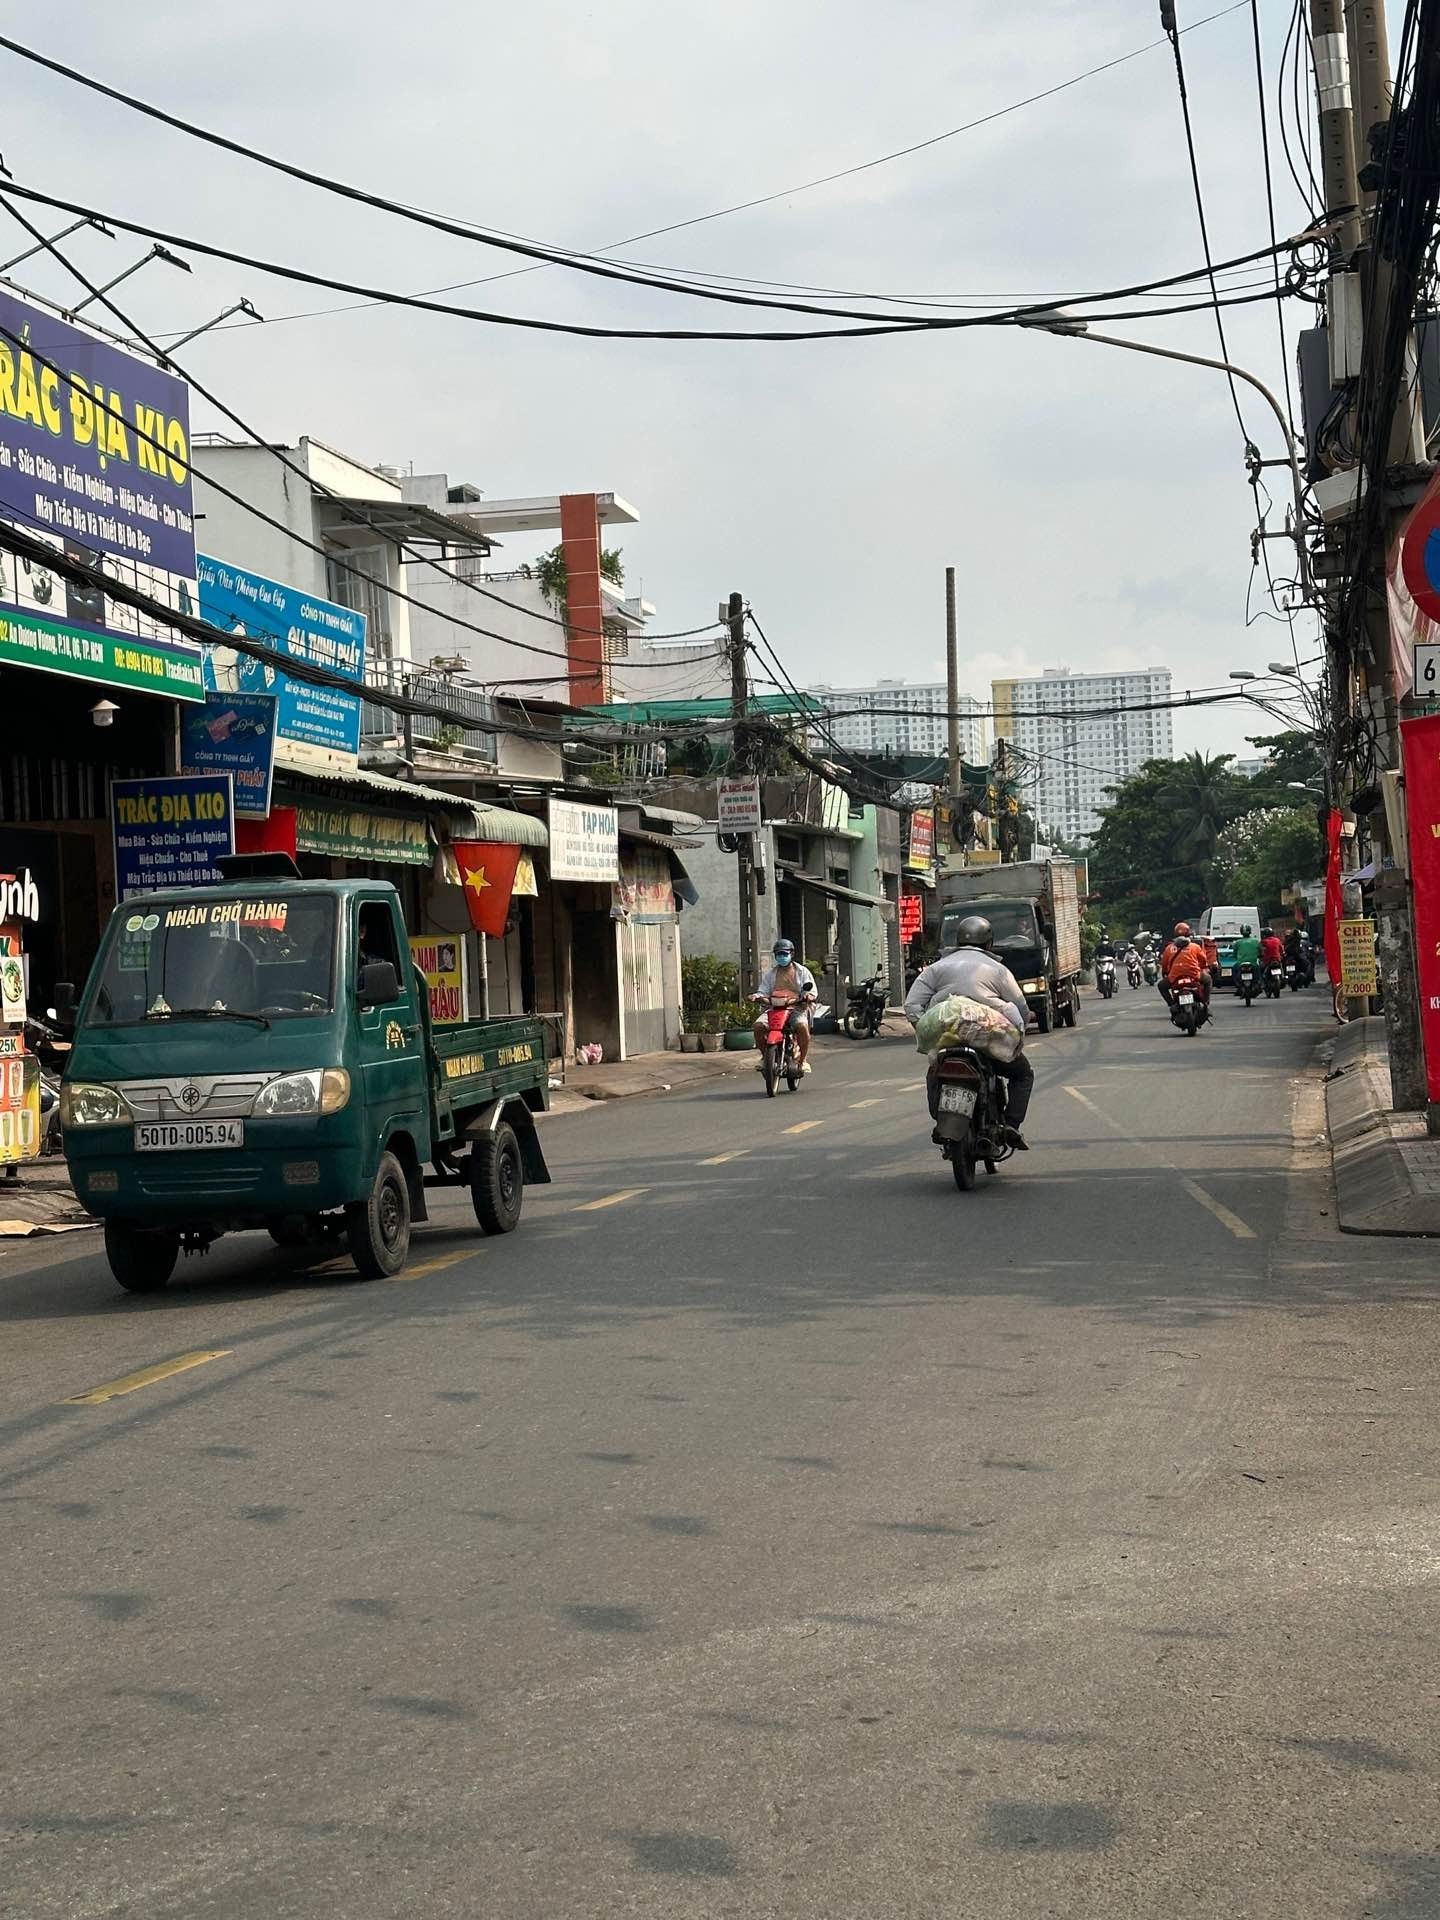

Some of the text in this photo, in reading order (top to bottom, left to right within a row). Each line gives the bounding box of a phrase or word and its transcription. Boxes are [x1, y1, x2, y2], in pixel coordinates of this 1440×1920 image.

[70, 371, 130, 471] ĐỊA
[135, 401, 188, 487] KIO
[63, 463, 84, 494] Kiểm
[85, 473, 113, 507] Nghiệm
[35, 493, 53, 523] Máy
[54, 498, 72, 526] Trắc
[117, 787, 225, 828] TRẮC ĐỊA KIO
[165, 904, 208, 928] NHẬN
[210, 899, 242, 922] CHỞ
[245, 900, 288, 920] HÀNG
[1344, 923, 1370, 936] CHÈ
[1345, 983, 1371, 993] 7.000
